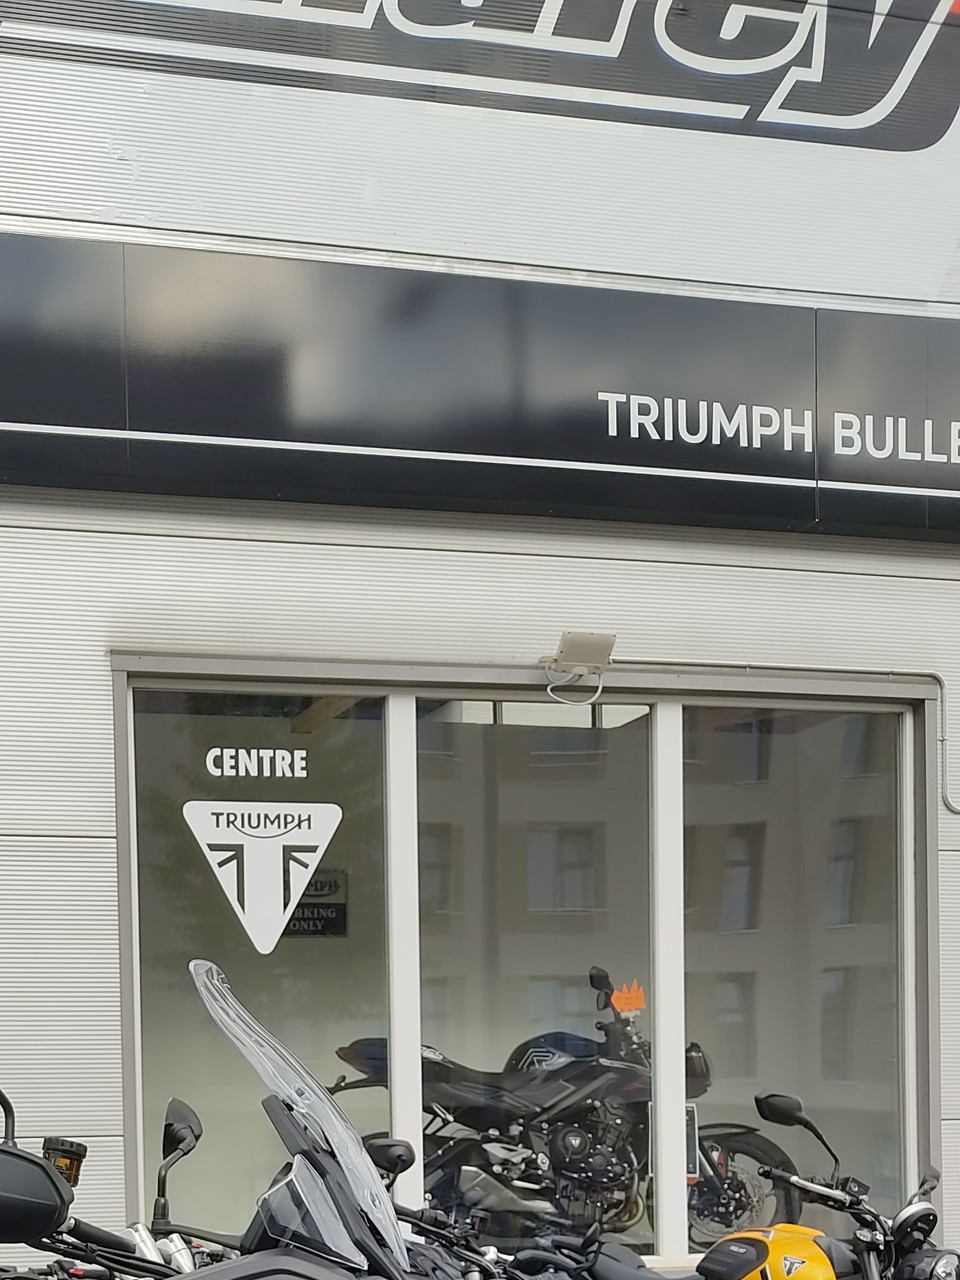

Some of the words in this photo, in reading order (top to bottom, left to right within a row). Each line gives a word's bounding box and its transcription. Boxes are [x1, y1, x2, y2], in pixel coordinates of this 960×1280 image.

[597, 391, 814, 454] TRIUMPH
[205, 747, 309, 779] CENTRE
[210, 812, 312, 838] TRIUMPH
[288, 920, 325, 931] ONLY
[293, 907, 337, 919] RKING
